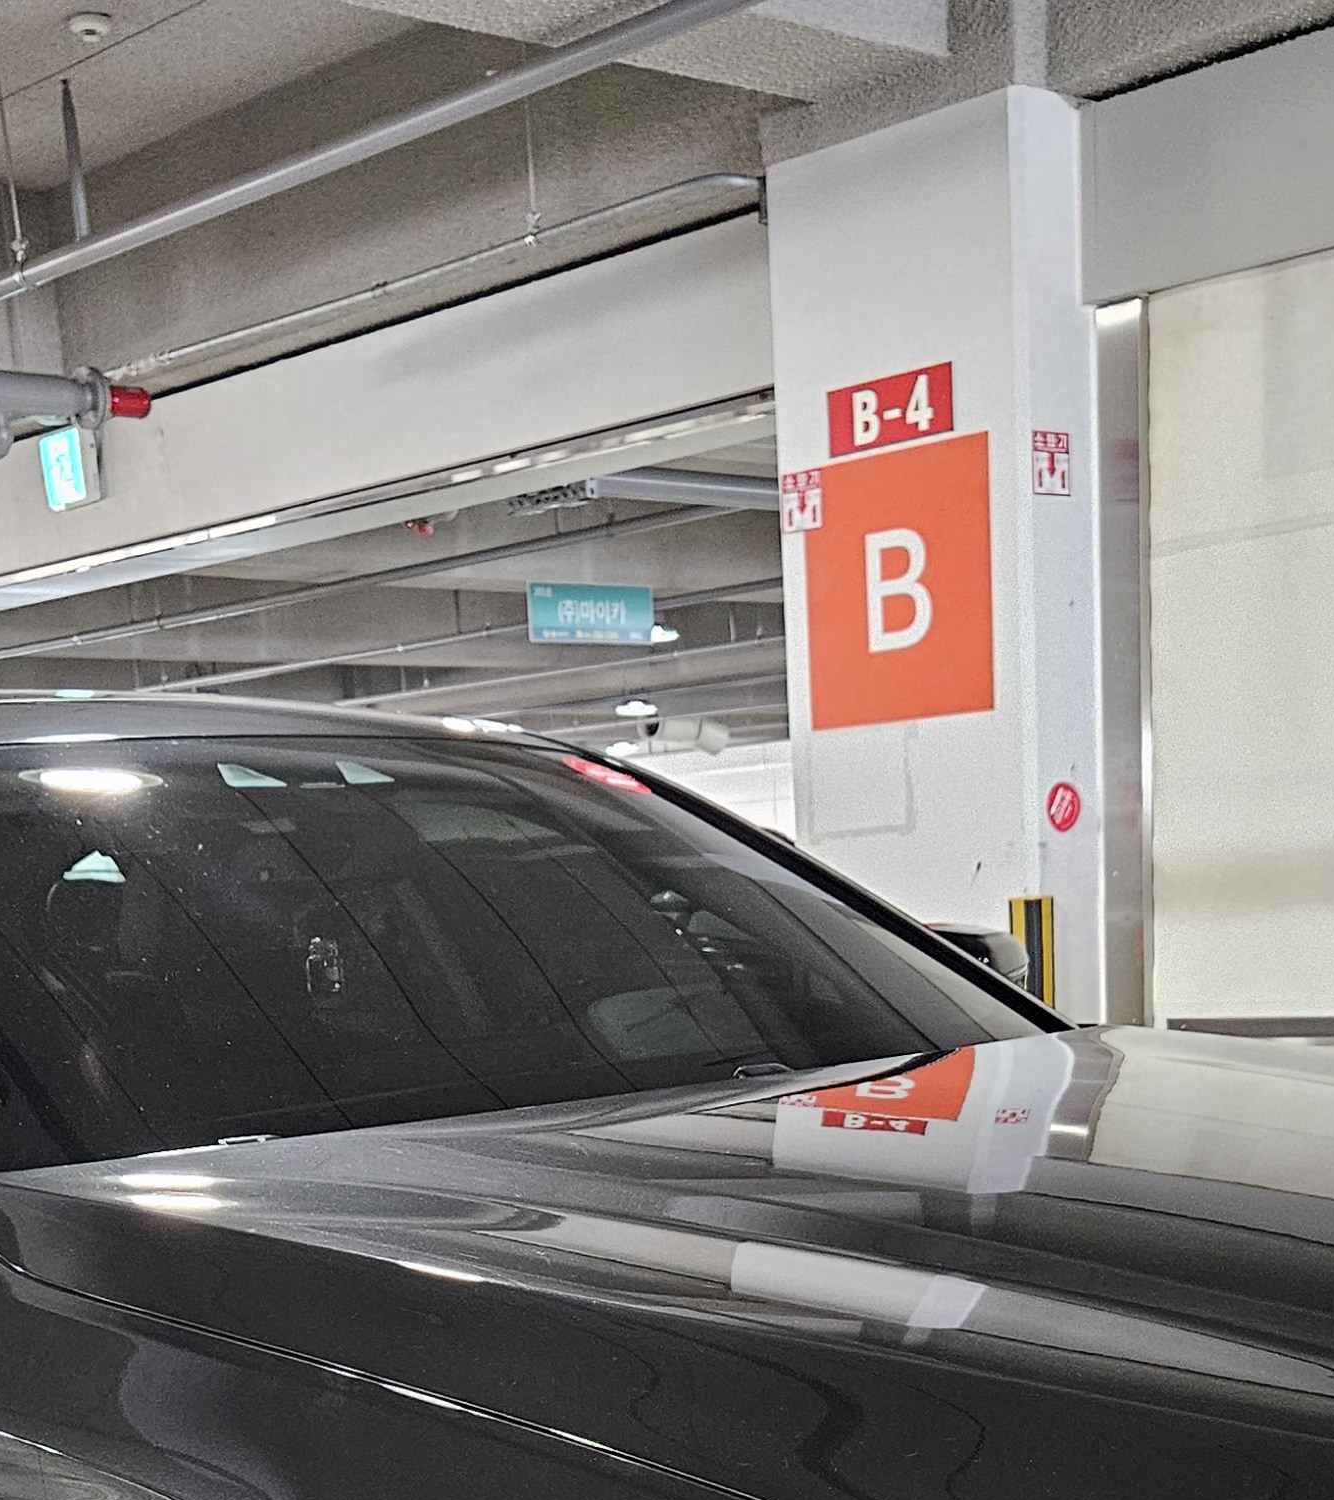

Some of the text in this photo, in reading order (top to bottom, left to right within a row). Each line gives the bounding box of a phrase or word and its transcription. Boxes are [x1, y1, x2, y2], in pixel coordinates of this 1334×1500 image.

[851, 373, 935, 446] B-4
[557, 599, 626, 626] (주)마이카
[864, 528, 934, 654] B
